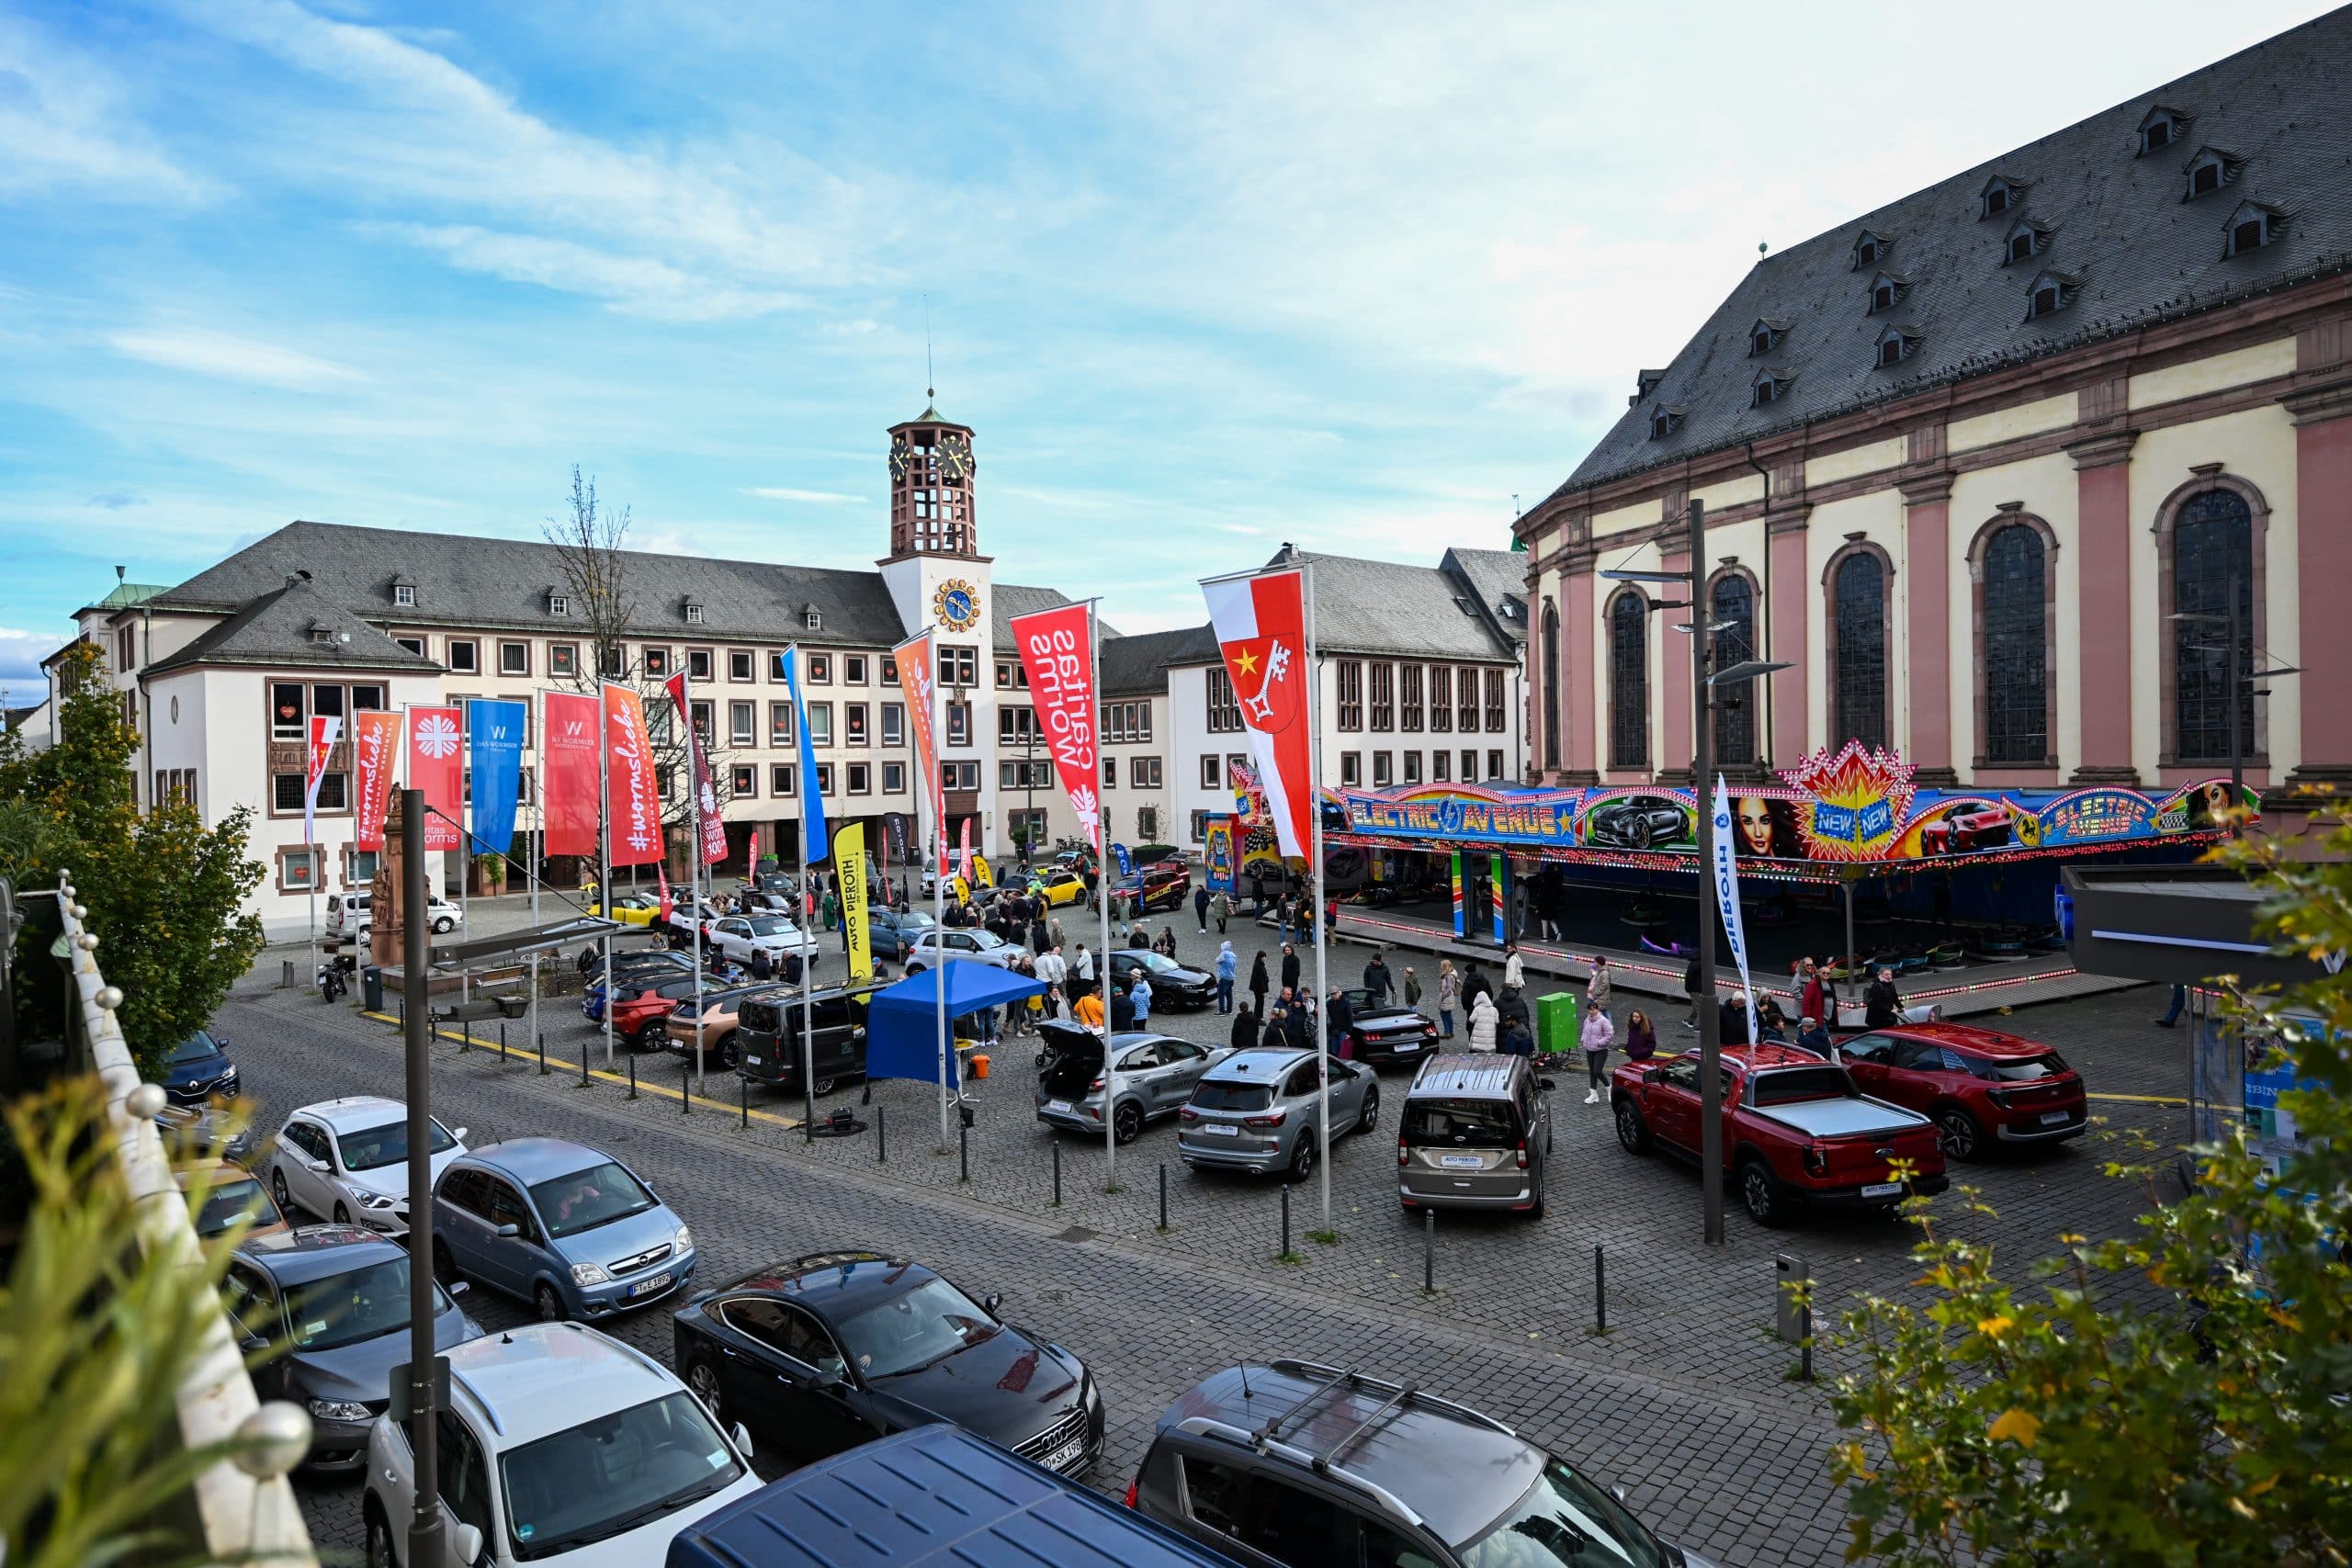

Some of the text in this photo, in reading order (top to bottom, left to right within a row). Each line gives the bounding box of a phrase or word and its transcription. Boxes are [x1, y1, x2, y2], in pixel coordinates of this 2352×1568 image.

[359, 721, 383, 842] #wormsliebe
[612, 698, 650, 852] #wormsliebe
[1352, 801, 1558, 838] ELECTRIC AVENUE
[1818, 814, 1853, 833] NEW
[1860, 809, 1889, 835] NEW
[2054, 796, 2147, 829] ELECTRIC
[424, 834, 458, 843] orms
[2064, 816, 2131, 840] AVENUE
[842, 860, 860, 952] AUTO PIEROTH
[1056, 1450, 1067, 1463] SK
